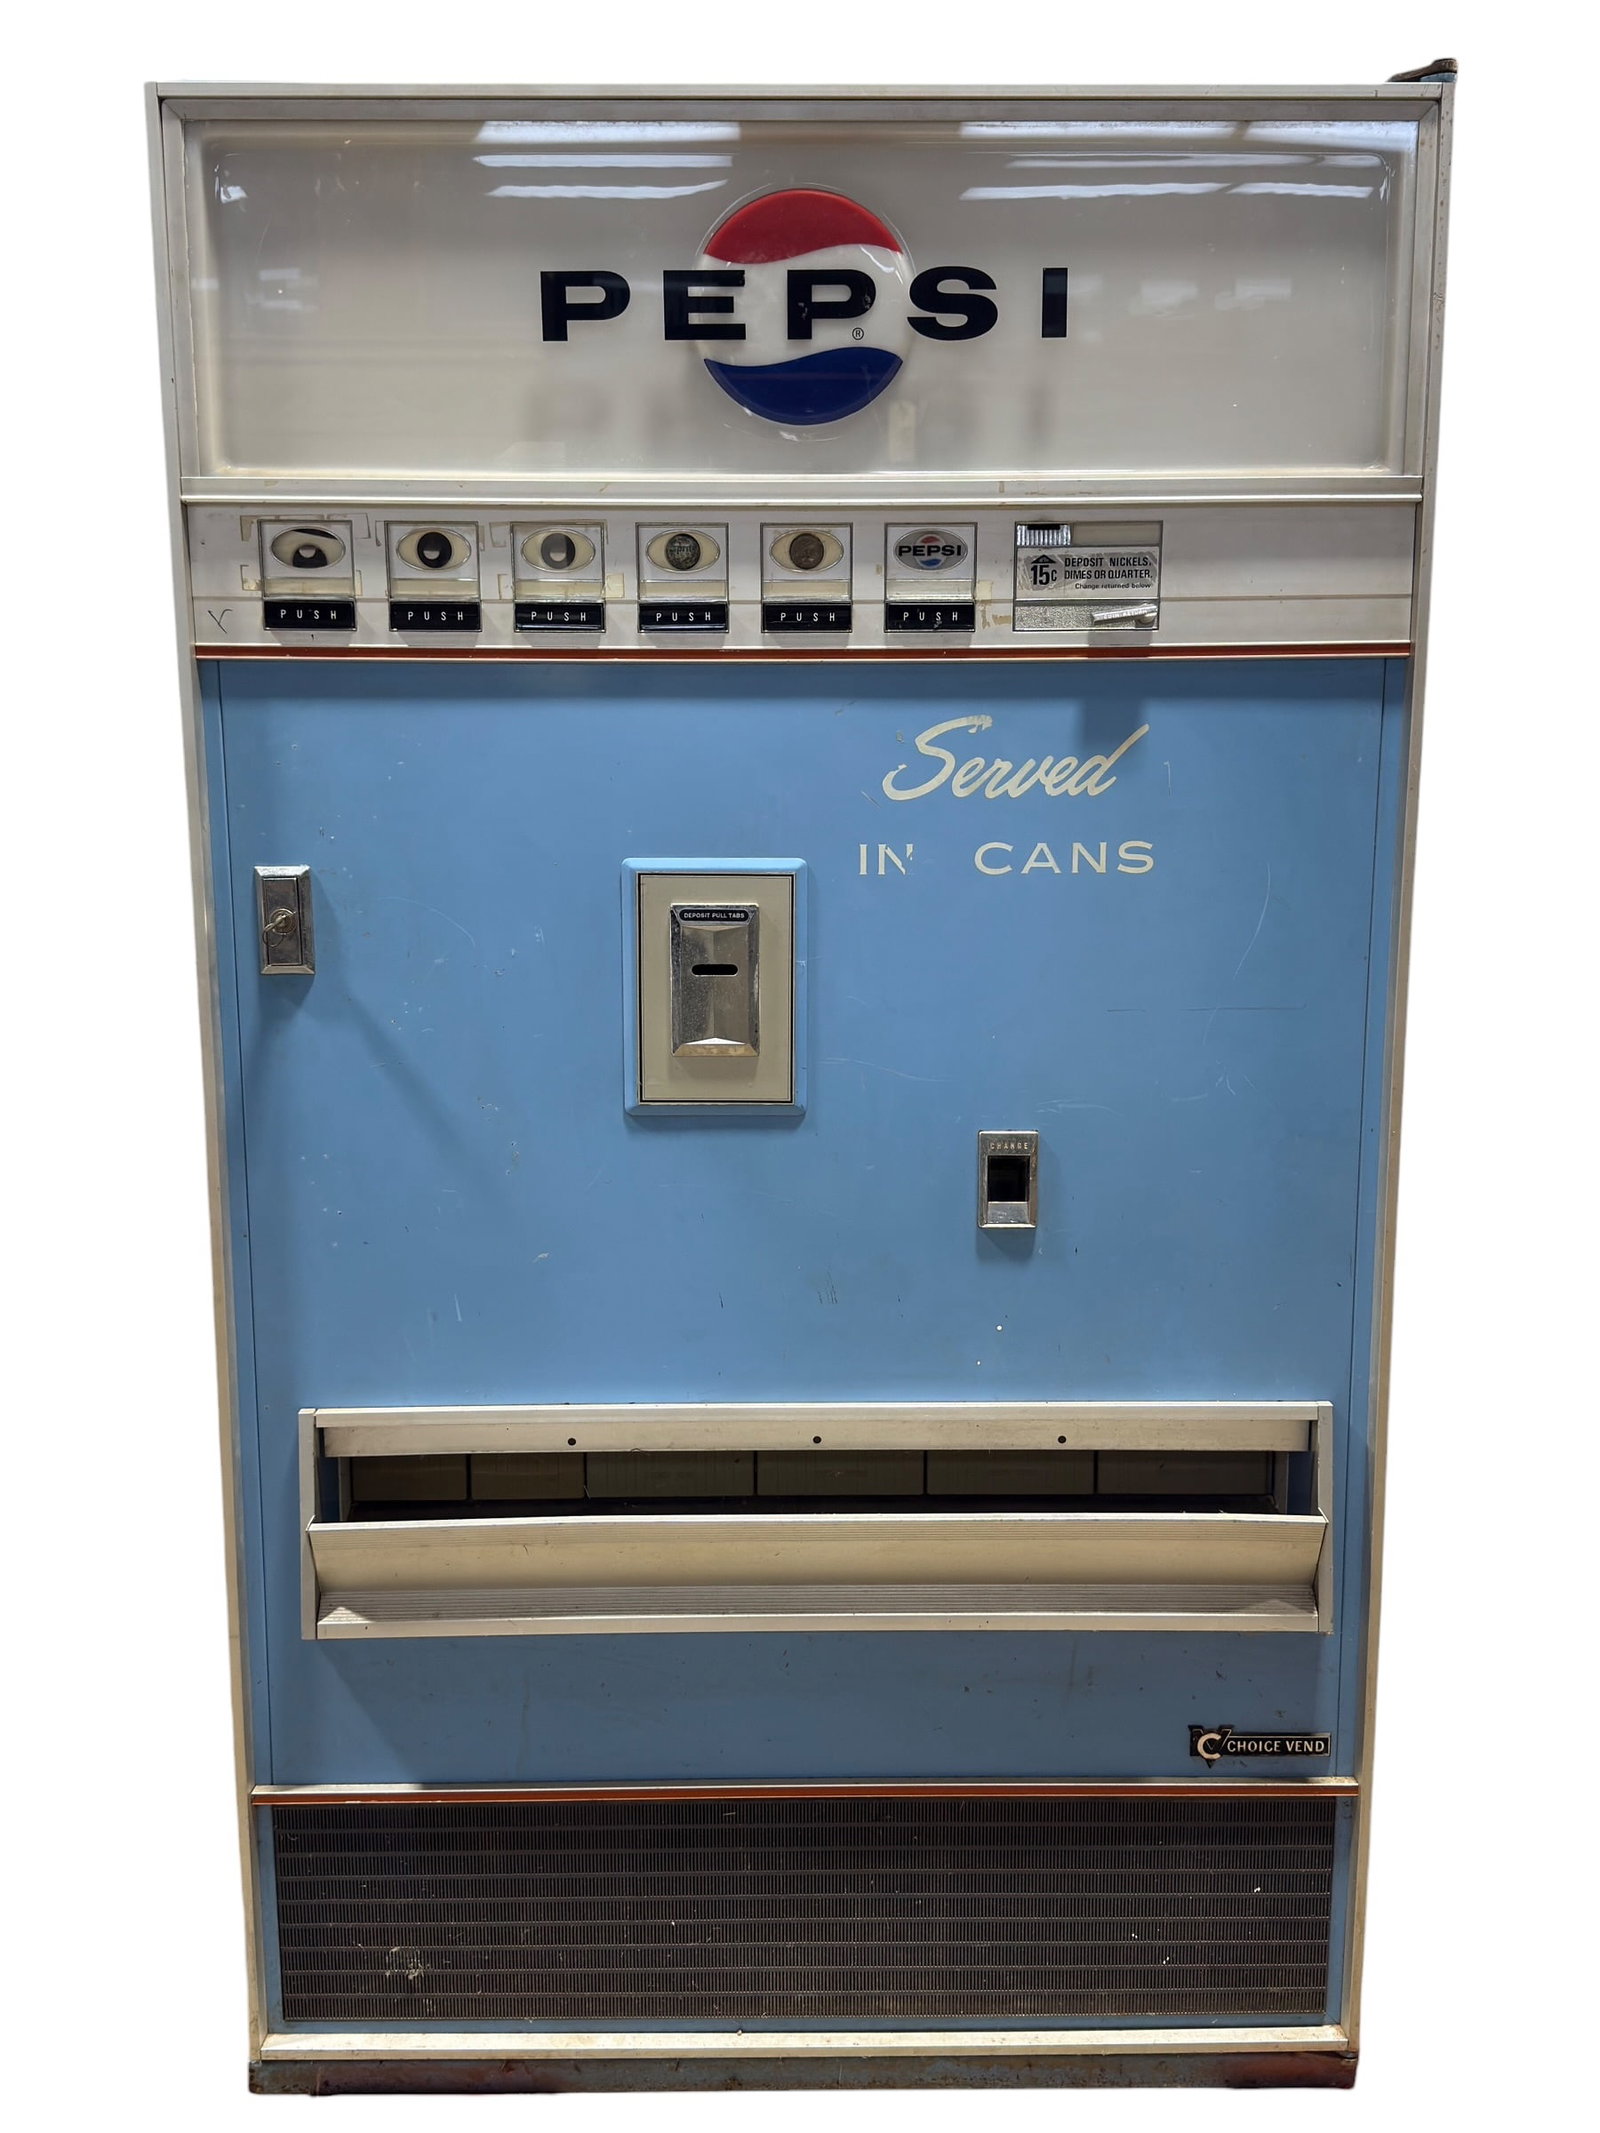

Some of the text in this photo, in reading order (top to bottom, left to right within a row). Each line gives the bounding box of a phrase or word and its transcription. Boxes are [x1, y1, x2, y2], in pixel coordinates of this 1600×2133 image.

[540, 266, 1068, 342] PEPSI
[898, 545, 962, 556] PEPSI
[1064, 557, 1104, 567] DEPOSIT
[1064, 569, 1091, 580] DIMES
[1094, 569, 1106, 580] OR
[280, 609, 337, 620] PUSH
[408, 611, 464, 621] PUSH
[530, 611, 588, 622] PUSH
[656, 612, 711, 622] PUSH
[780, 612, 835, 622] PUSH
[903, 612, 959, 622] PUSH
[882, 714, 1150, 801] Served
[974, 841, 1154, 876] CANS
[1227, 1740, 1325, 1753] CHOICE VEND
